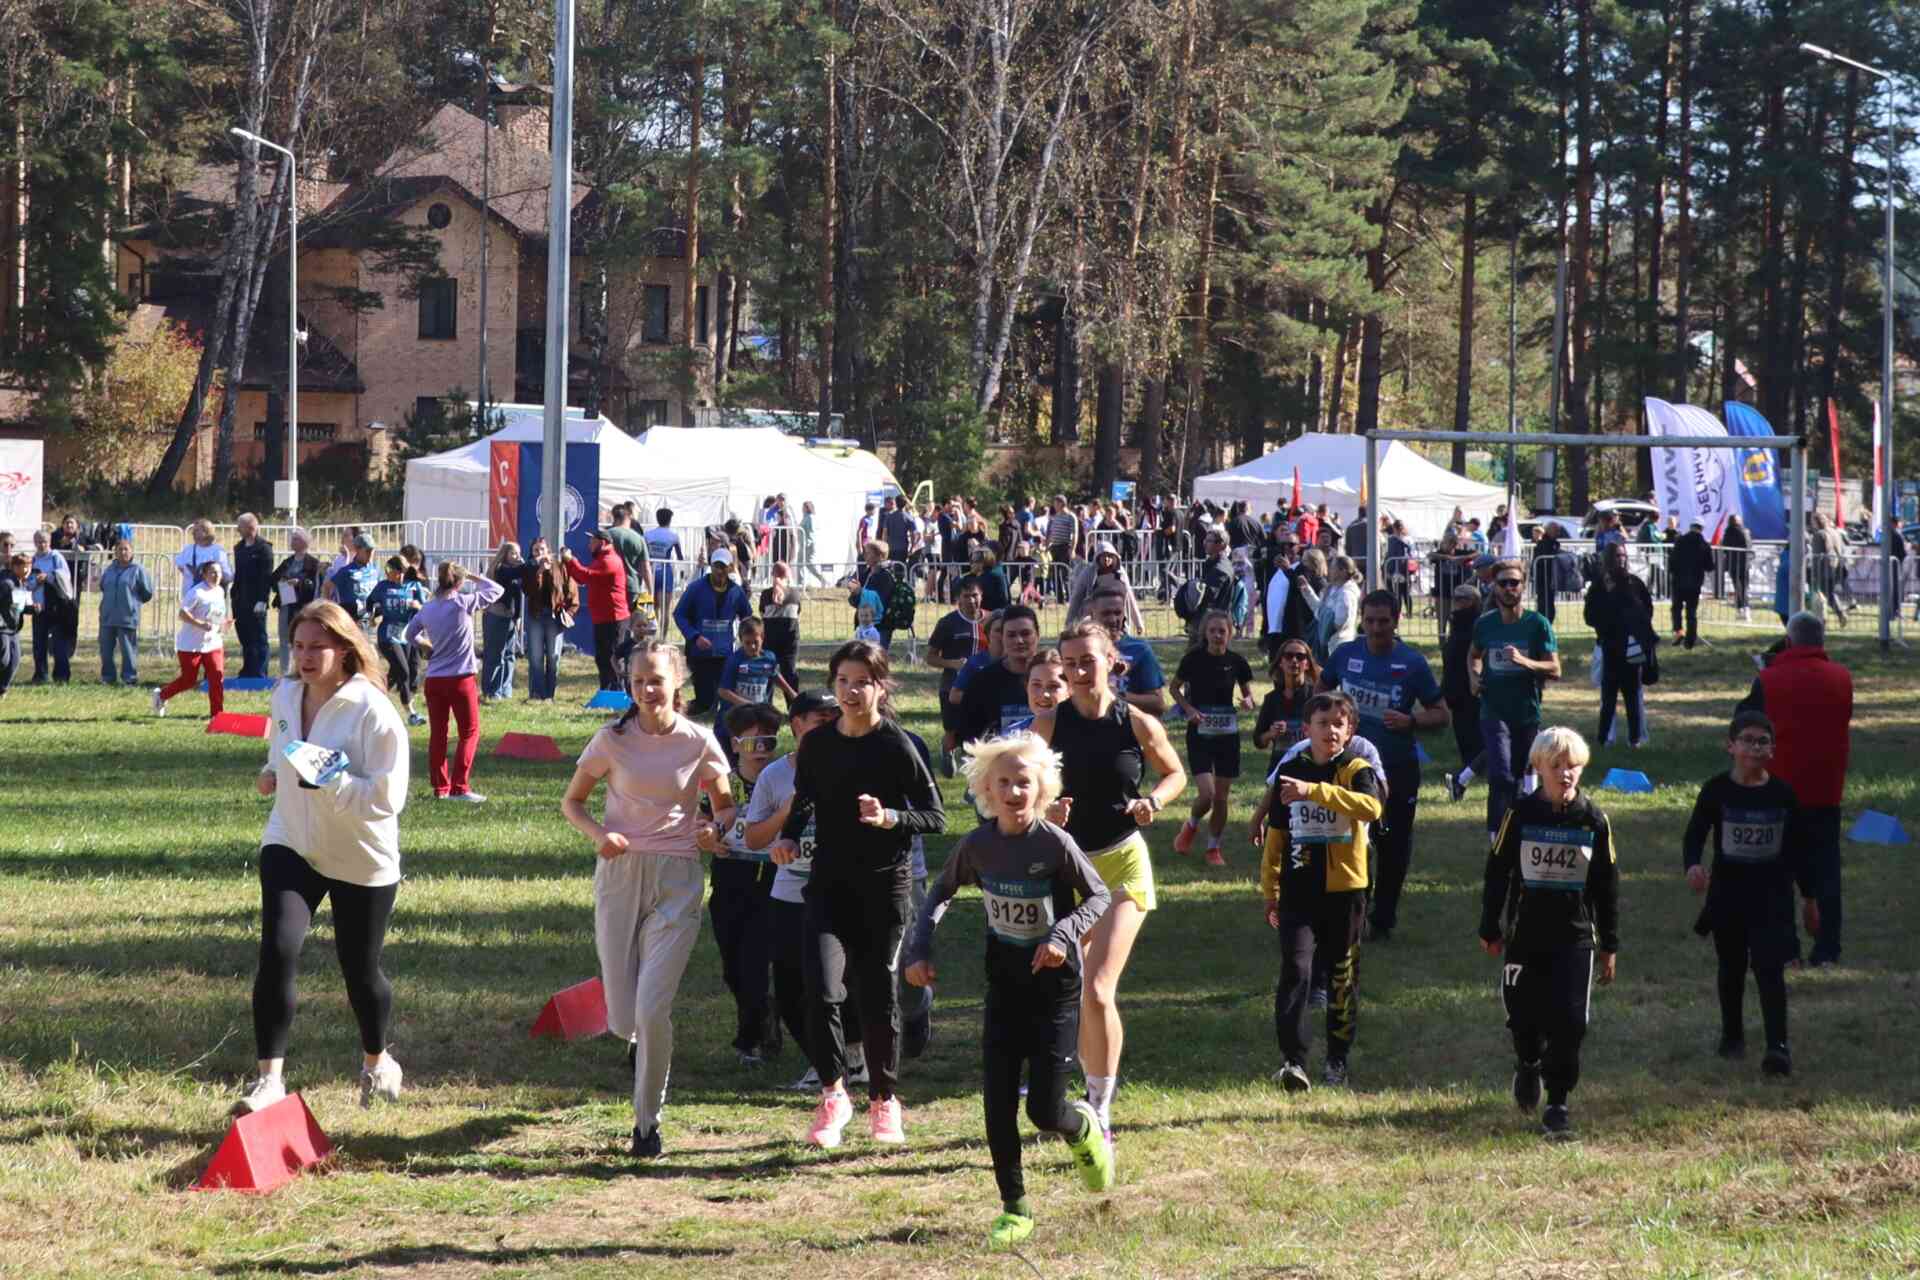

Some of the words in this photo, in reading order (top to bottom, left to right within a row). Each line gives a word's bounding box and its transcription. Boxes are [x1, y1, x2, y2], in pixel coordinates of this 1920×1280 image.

[1531, 846, 1577, 869] 9442
[991, 898, 1039, 925] 9129
[1504, 963, 1523, 986] 17
